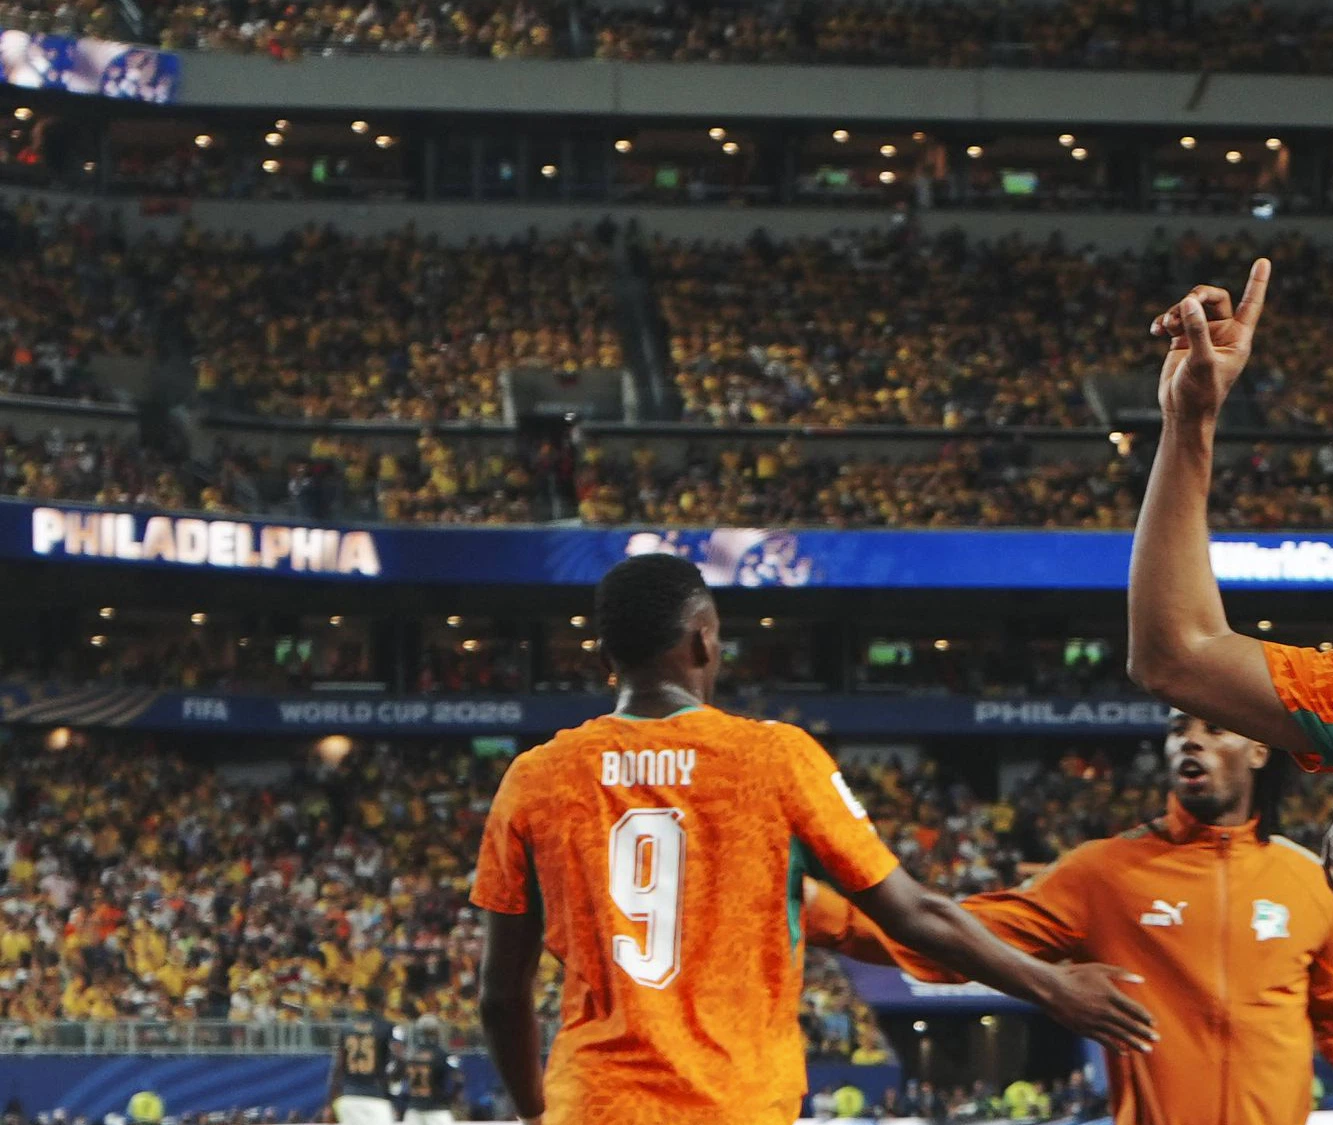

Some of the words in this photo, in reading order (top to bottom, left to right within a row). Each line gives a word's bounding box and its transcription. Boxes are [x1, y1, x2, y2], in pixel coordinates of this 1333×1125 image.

[32, 507, 381, 577] PHILADELPHIA
[280, 701, 373, 723] WORLD
[377, 701, 428, 723] CUP
[974, 701, 1171, 725] PHILADEL
[601, 749, 696, 787] BONNY
[609, 807, 686, 989] 9
